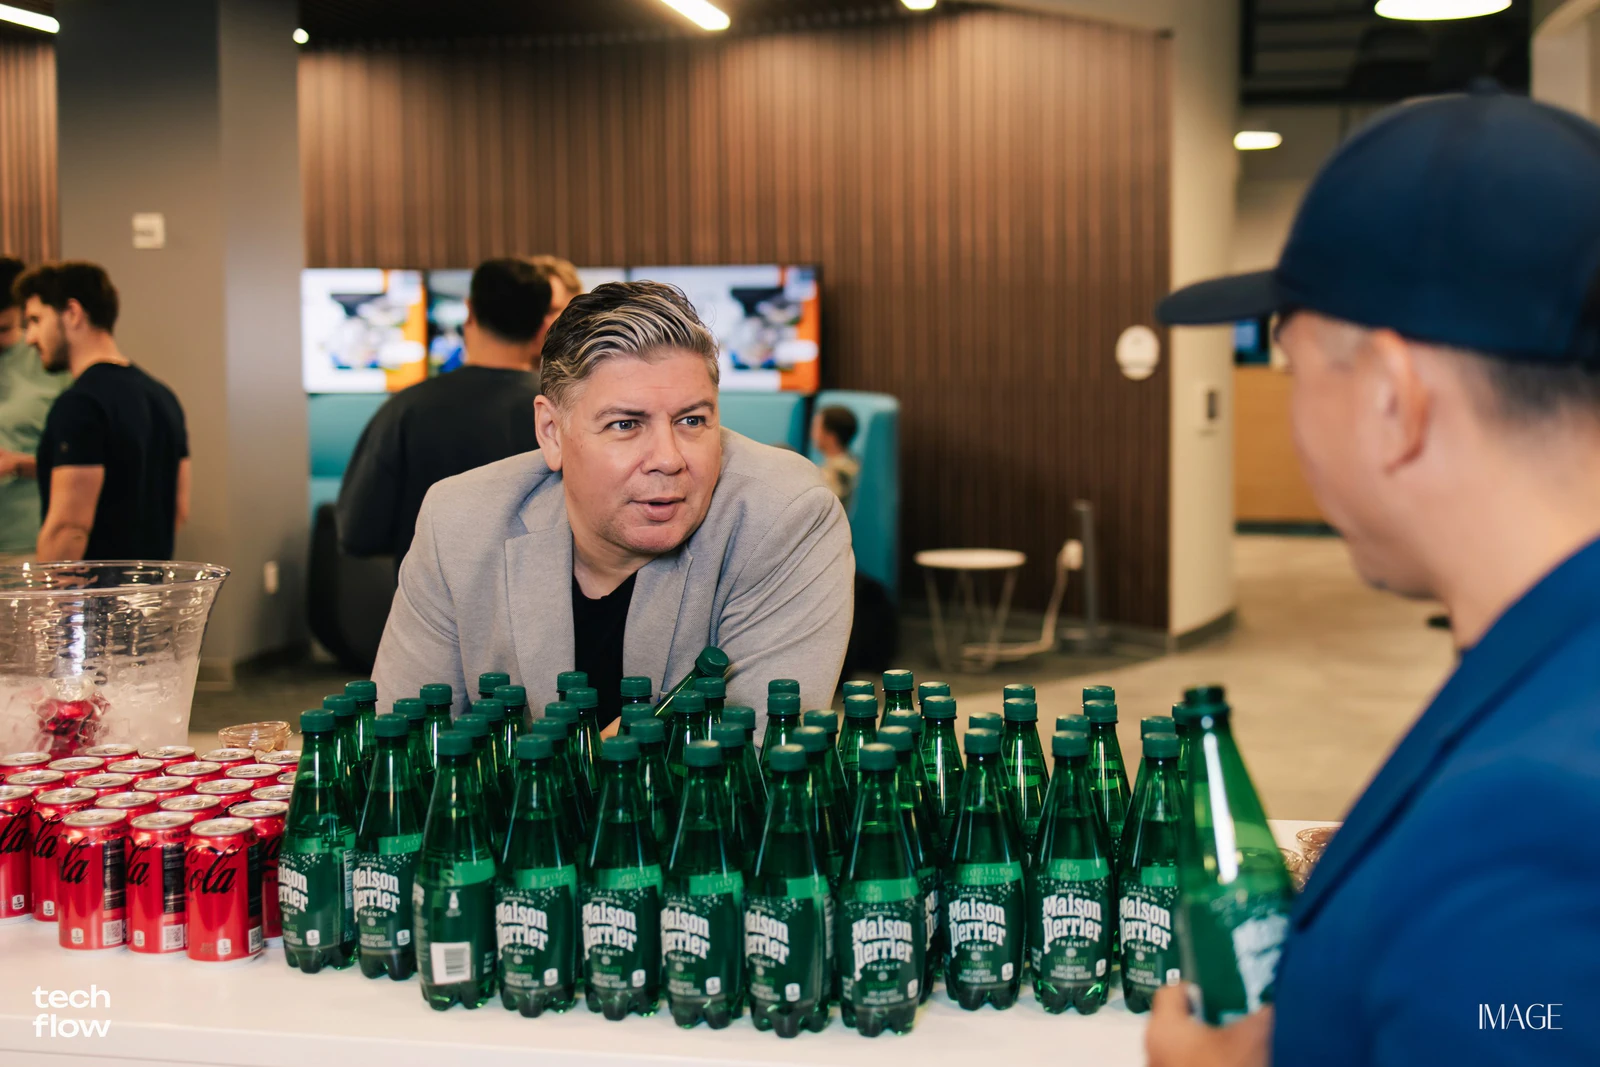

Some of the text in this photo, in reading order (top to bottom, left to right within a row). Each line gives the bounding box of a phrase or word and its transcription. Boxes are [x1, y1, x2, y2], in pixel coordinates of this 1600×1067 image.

[949, 897, 1007, 926] Maison
[1042, 892, 1103, 922] Maison
[852, 915, 913, 944] Maison
[1055, 939, 1090, 948] FRANCE
